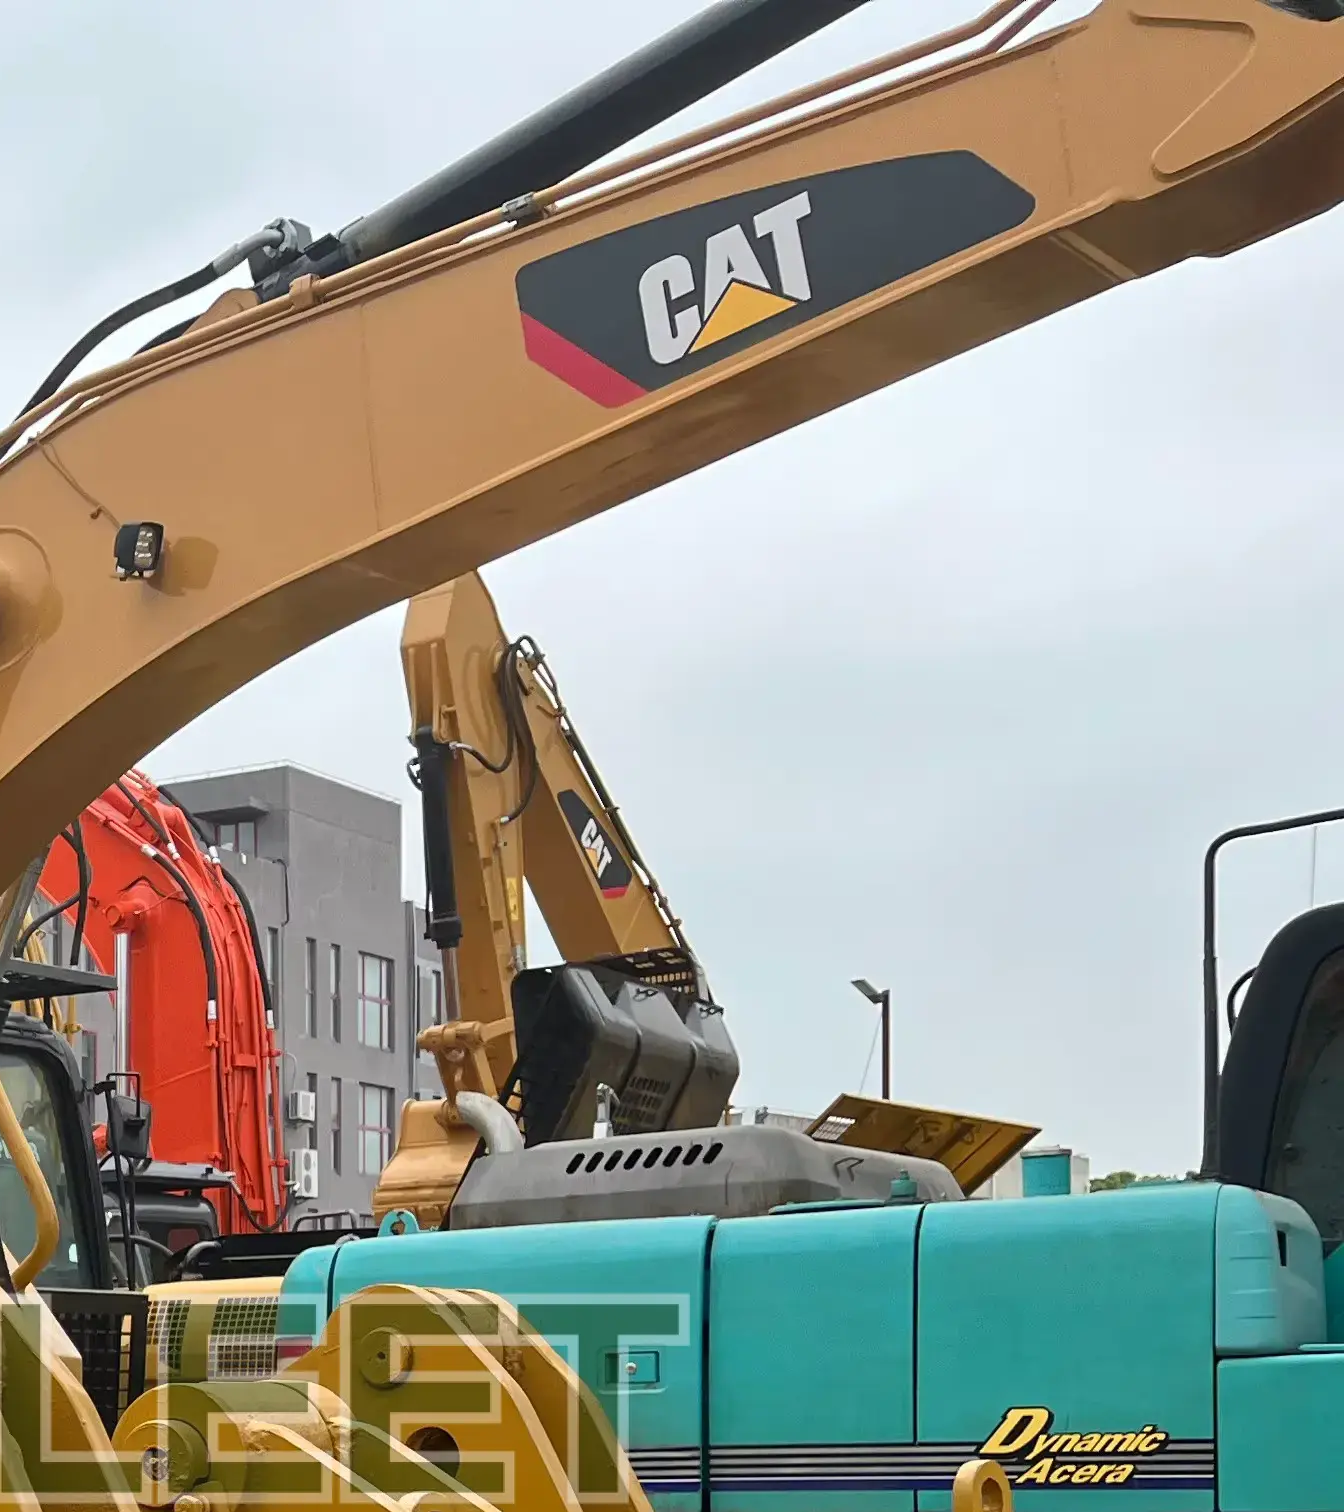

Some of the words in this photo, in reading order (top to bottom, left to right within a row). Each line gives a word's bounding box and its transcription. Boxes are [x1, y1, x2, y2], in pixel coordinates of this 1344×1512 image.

[638, 191, 812, 365] CAT
[581, 818, 612, 878] CAT
[979, 1405, 1168, 1461] Dynamic
[1015, 1457, 1135, 1484] Acera
